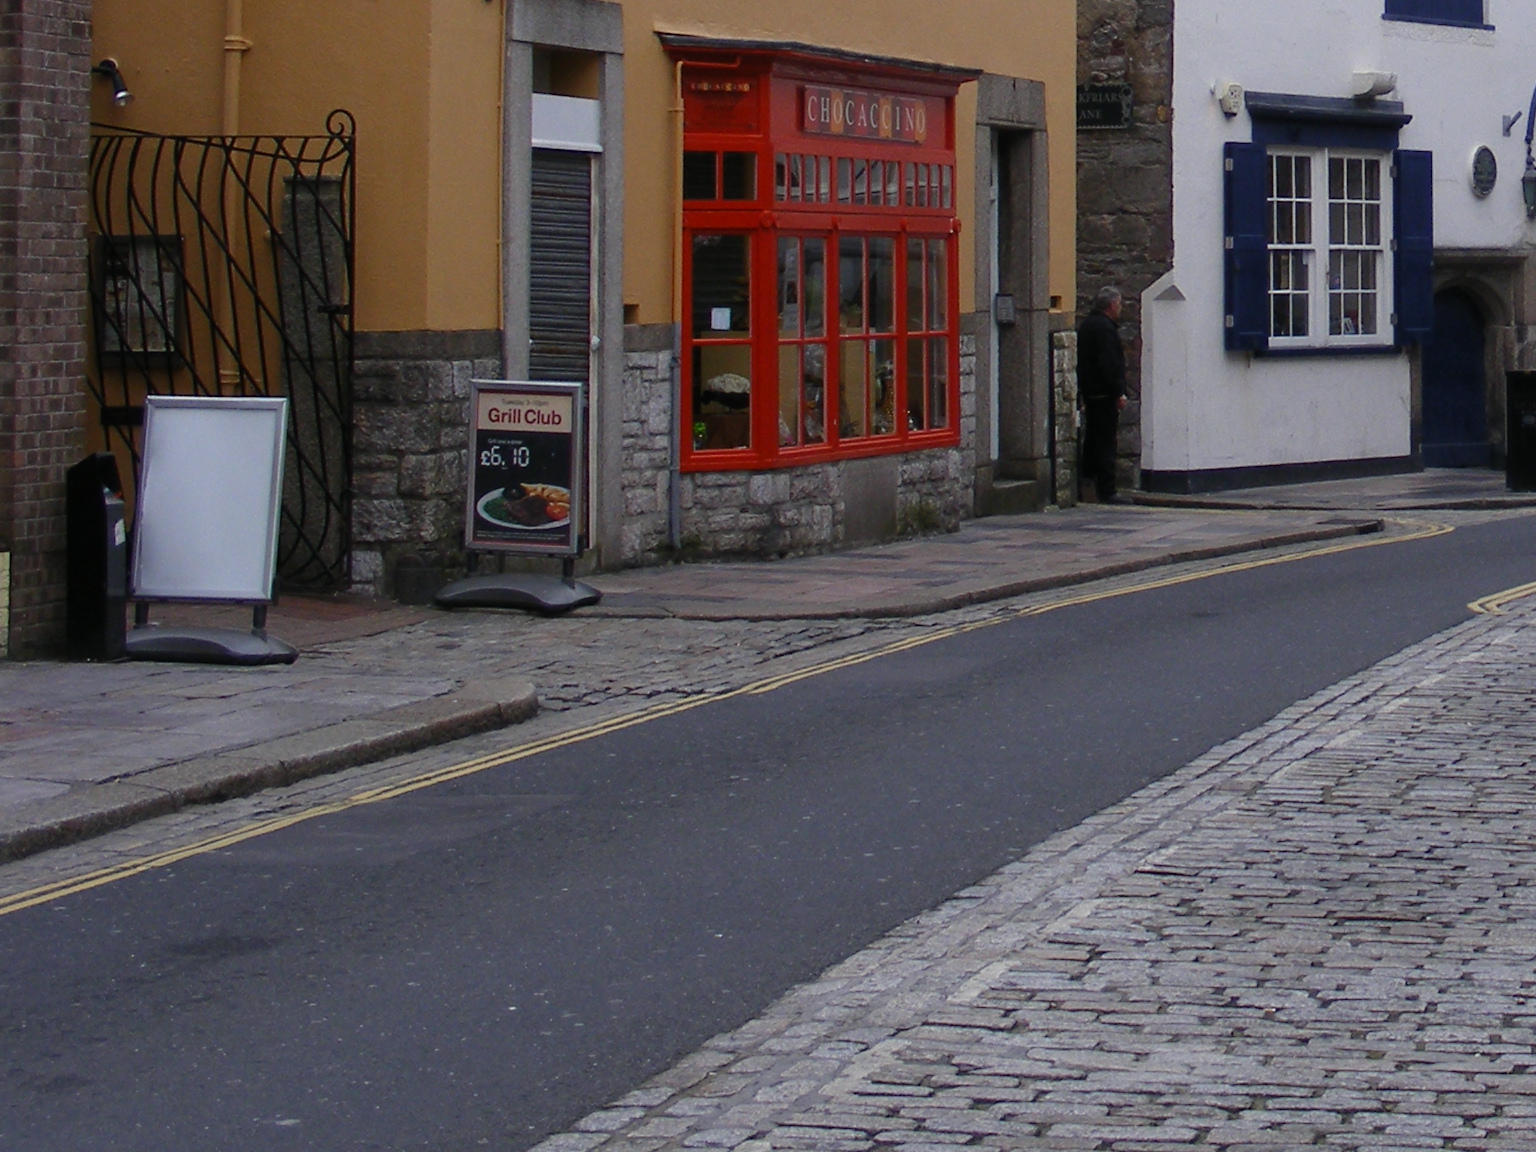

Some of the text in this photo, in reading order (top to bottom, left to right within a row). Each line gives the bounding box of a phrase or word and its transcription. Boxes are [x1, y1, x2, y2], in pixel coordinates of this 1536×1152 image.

[807, 95, 926, 134] CHOCACCINO
[488, 408, 562, 425] Grill Club
